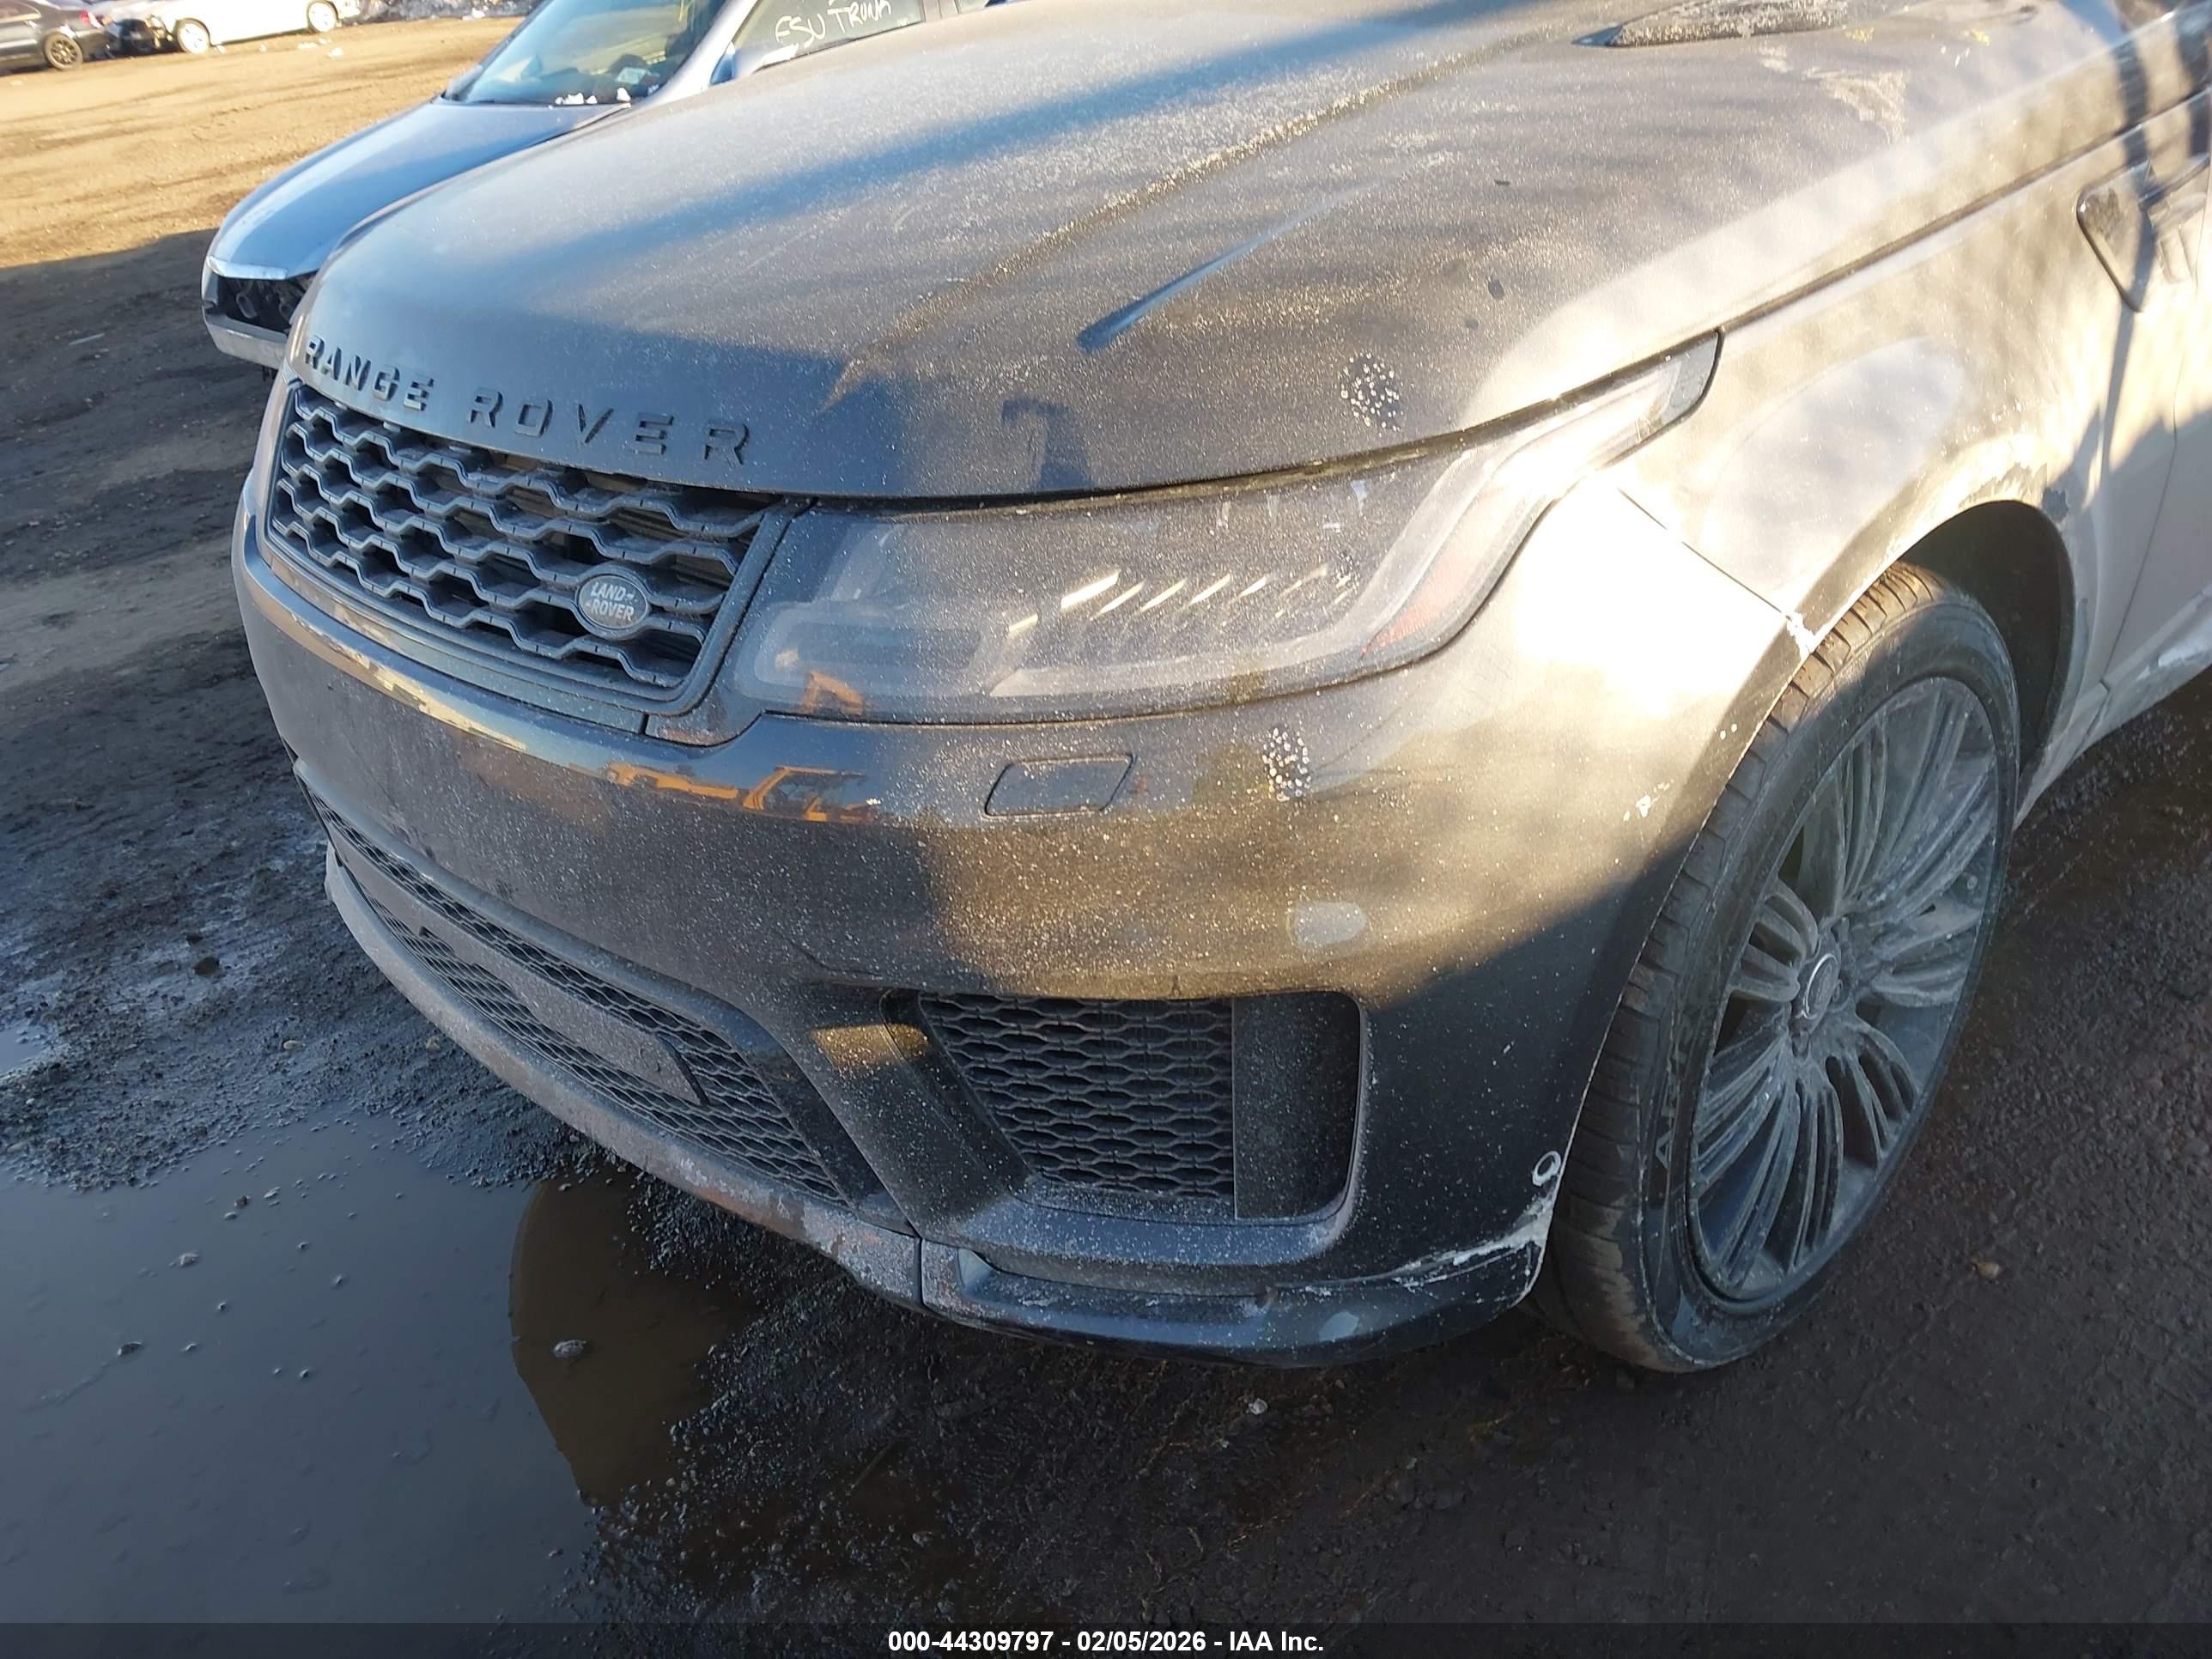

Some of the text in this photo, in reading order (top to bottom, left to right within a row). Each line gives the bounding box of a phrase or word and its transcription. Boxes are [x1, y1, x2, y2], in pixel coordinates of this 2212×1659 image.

[304, 334, 751, 466] RANGE ROVER
[590, 582, 627, 601] LAND
[591, 599, 635, 622] ROVER
